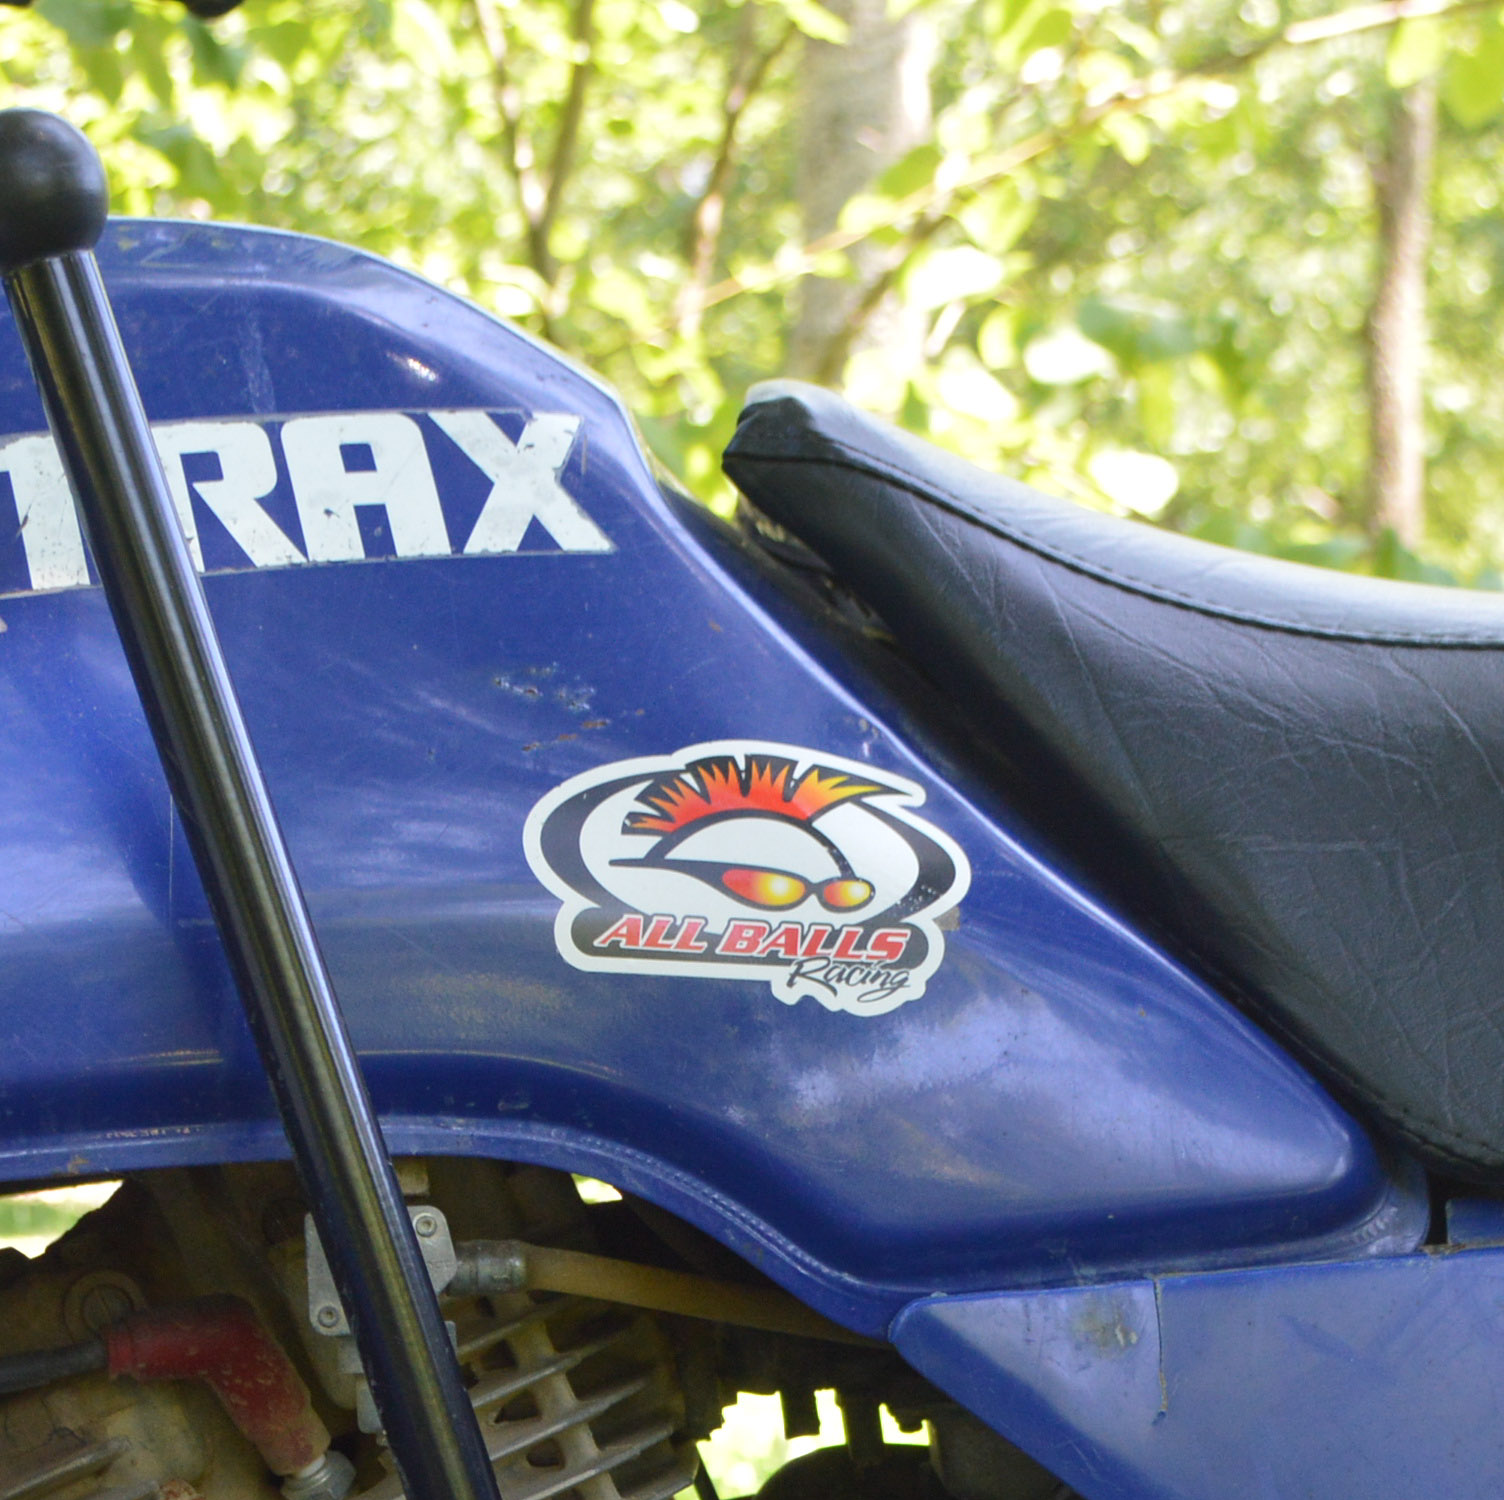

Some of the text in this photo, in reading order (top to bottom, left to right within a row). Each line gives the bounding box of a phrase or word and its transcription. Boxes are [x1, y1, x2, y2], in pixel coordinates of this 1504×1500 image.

[594, 914, 911, 962] ALL BALLS
[786, 957, 910, 1003] Racing
